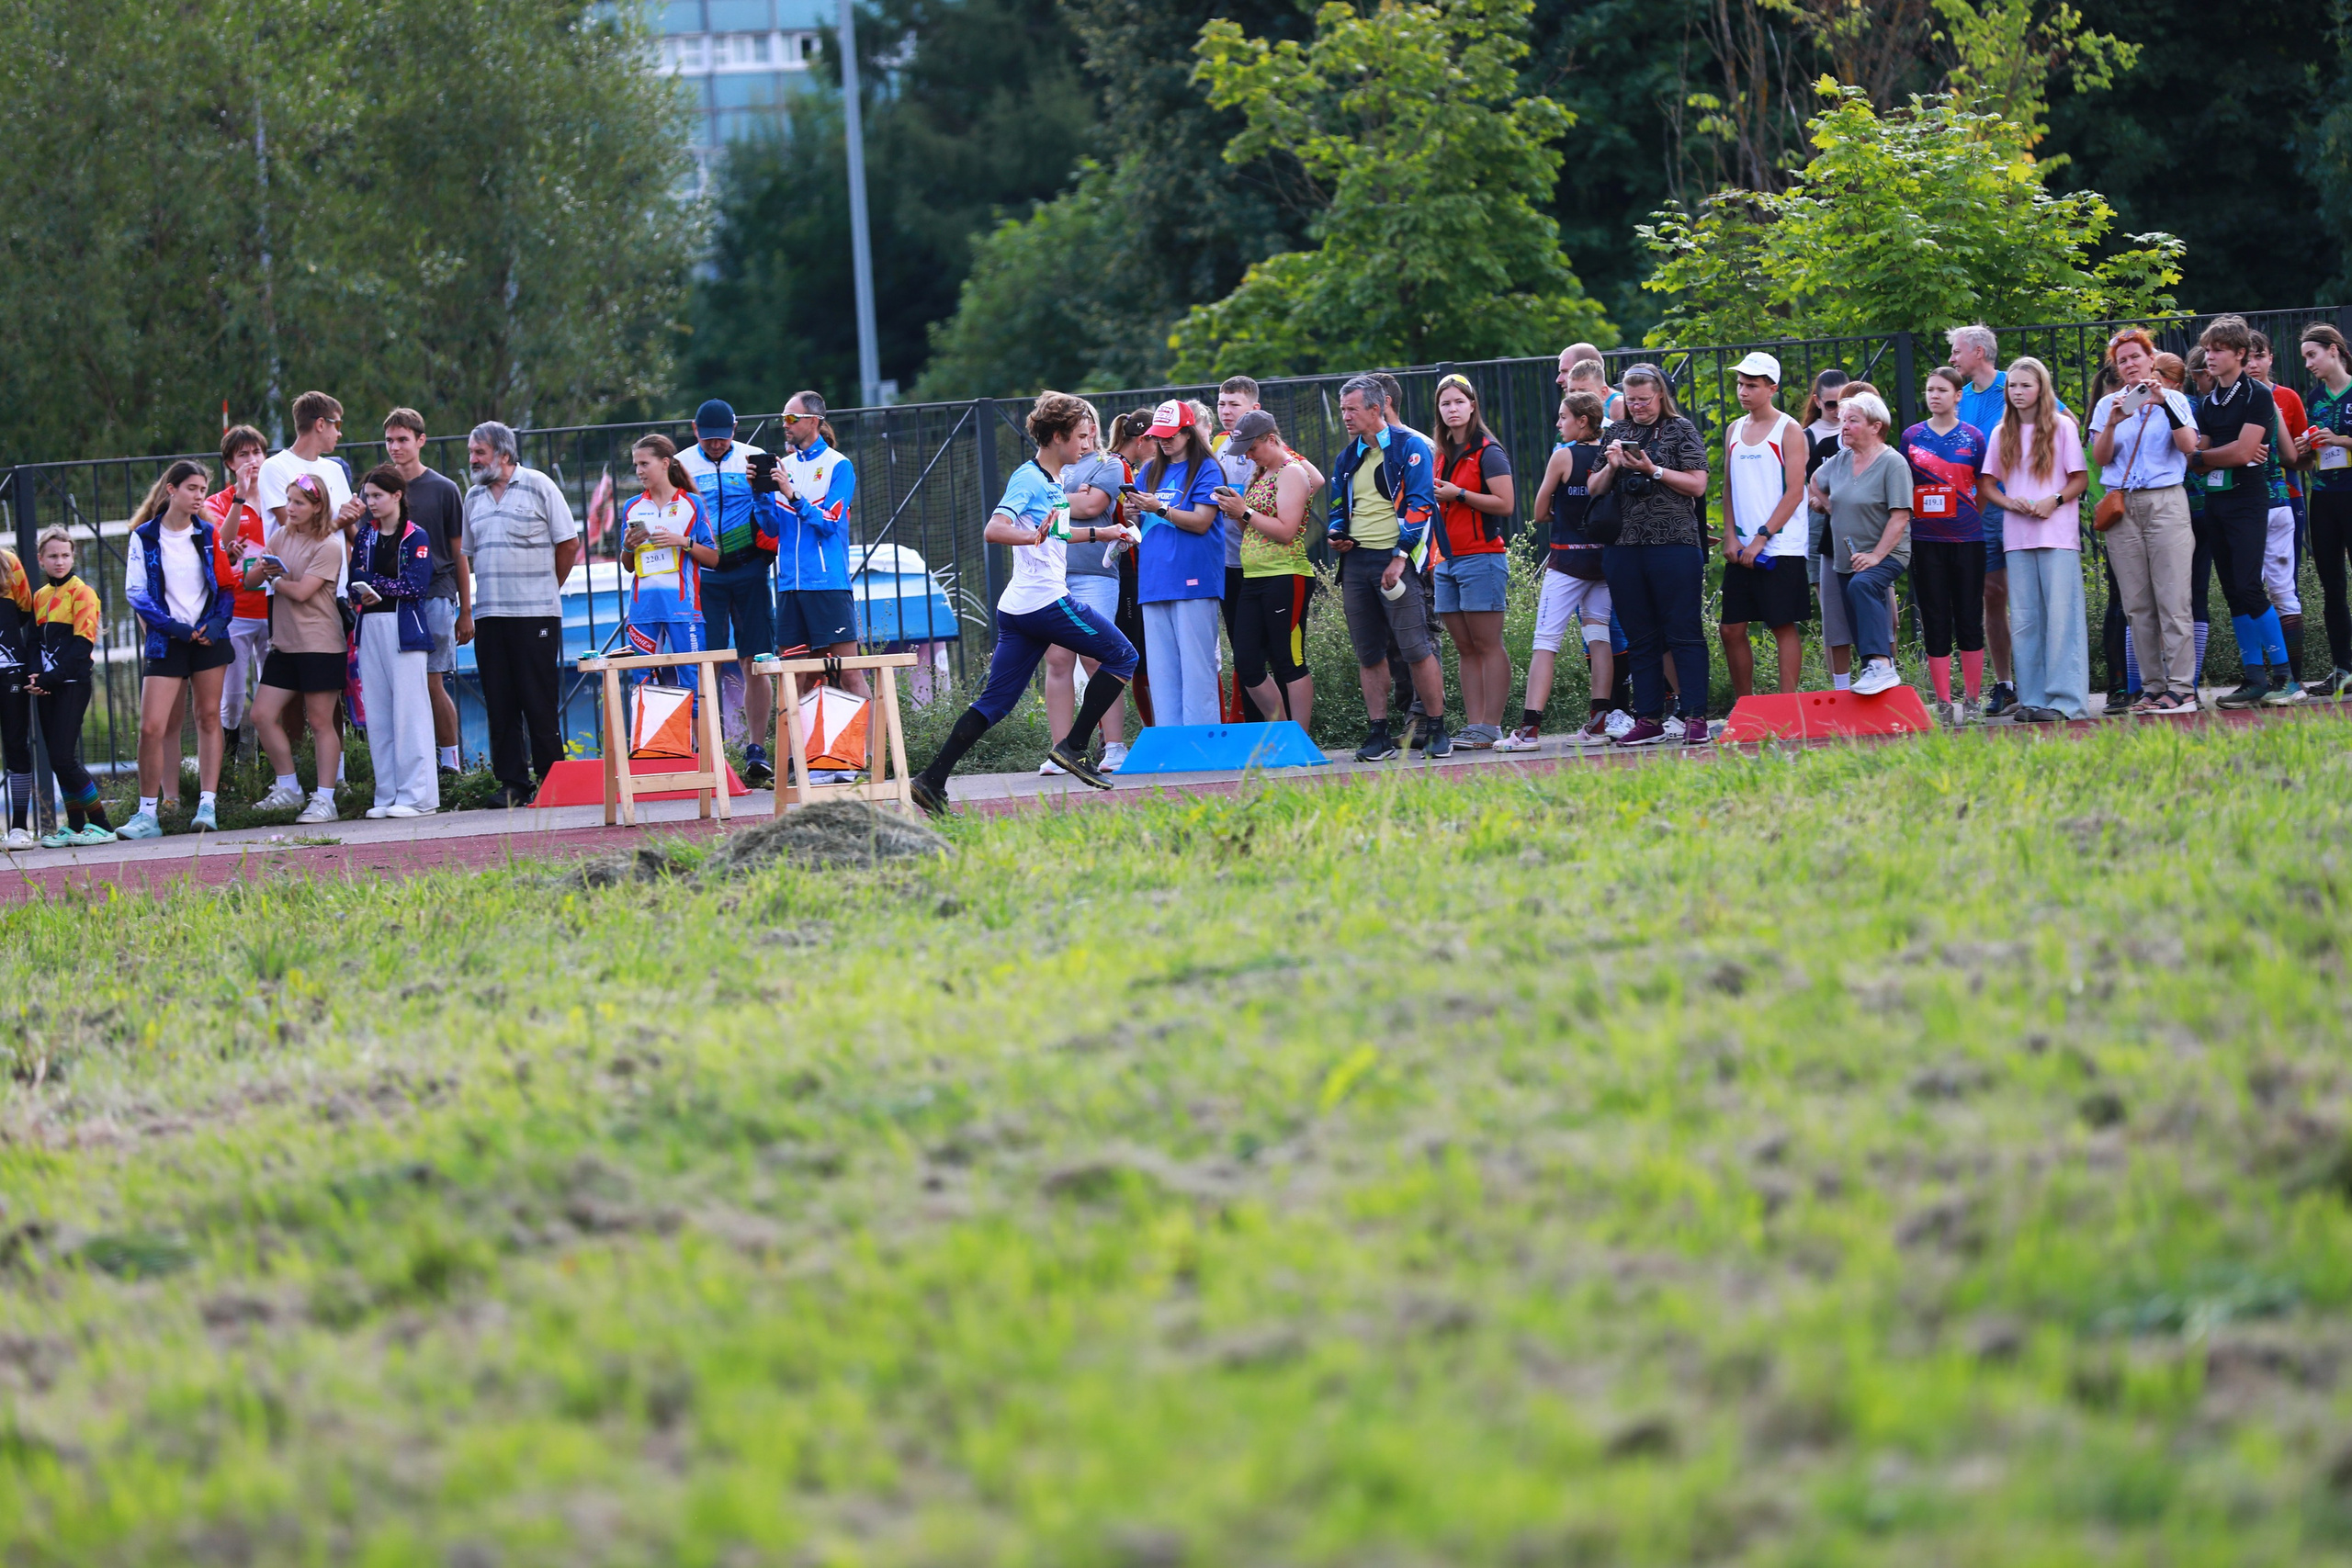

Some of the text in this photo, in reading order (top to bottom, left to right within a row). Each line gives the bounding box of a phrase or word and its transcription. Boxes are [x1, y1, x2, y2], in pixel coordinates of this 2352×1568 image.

[2222, 381, 2242, 406] noname
[1925, 498, 1943, 506] 419.1
[646, 553, 665, 564] 220.1
